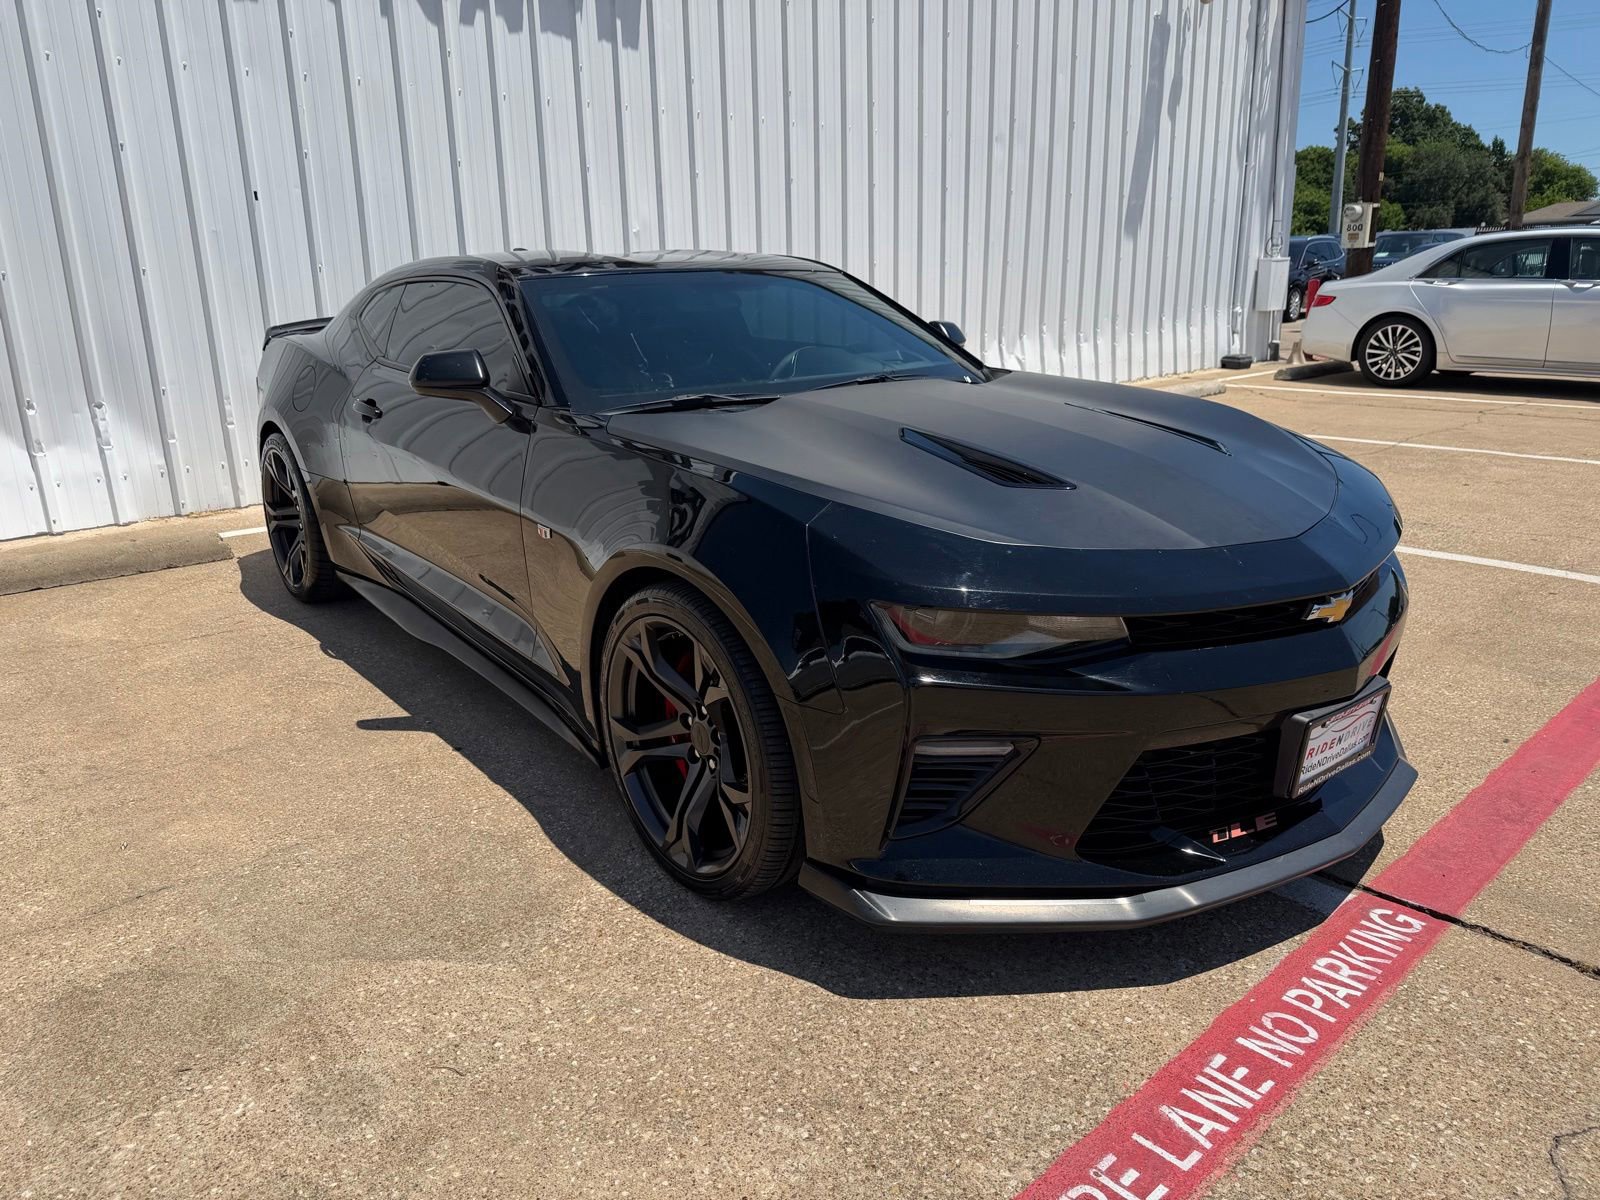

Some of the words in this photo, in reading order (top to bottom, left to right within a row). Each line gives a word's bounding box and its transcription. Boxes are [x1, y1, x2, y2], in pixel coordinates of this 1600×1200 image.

[1131, 1053, 1275, 1171] LANE
[1236, 1011, 1319, 1068] NO
[1282, 908, 1427, 1021] PARKING
